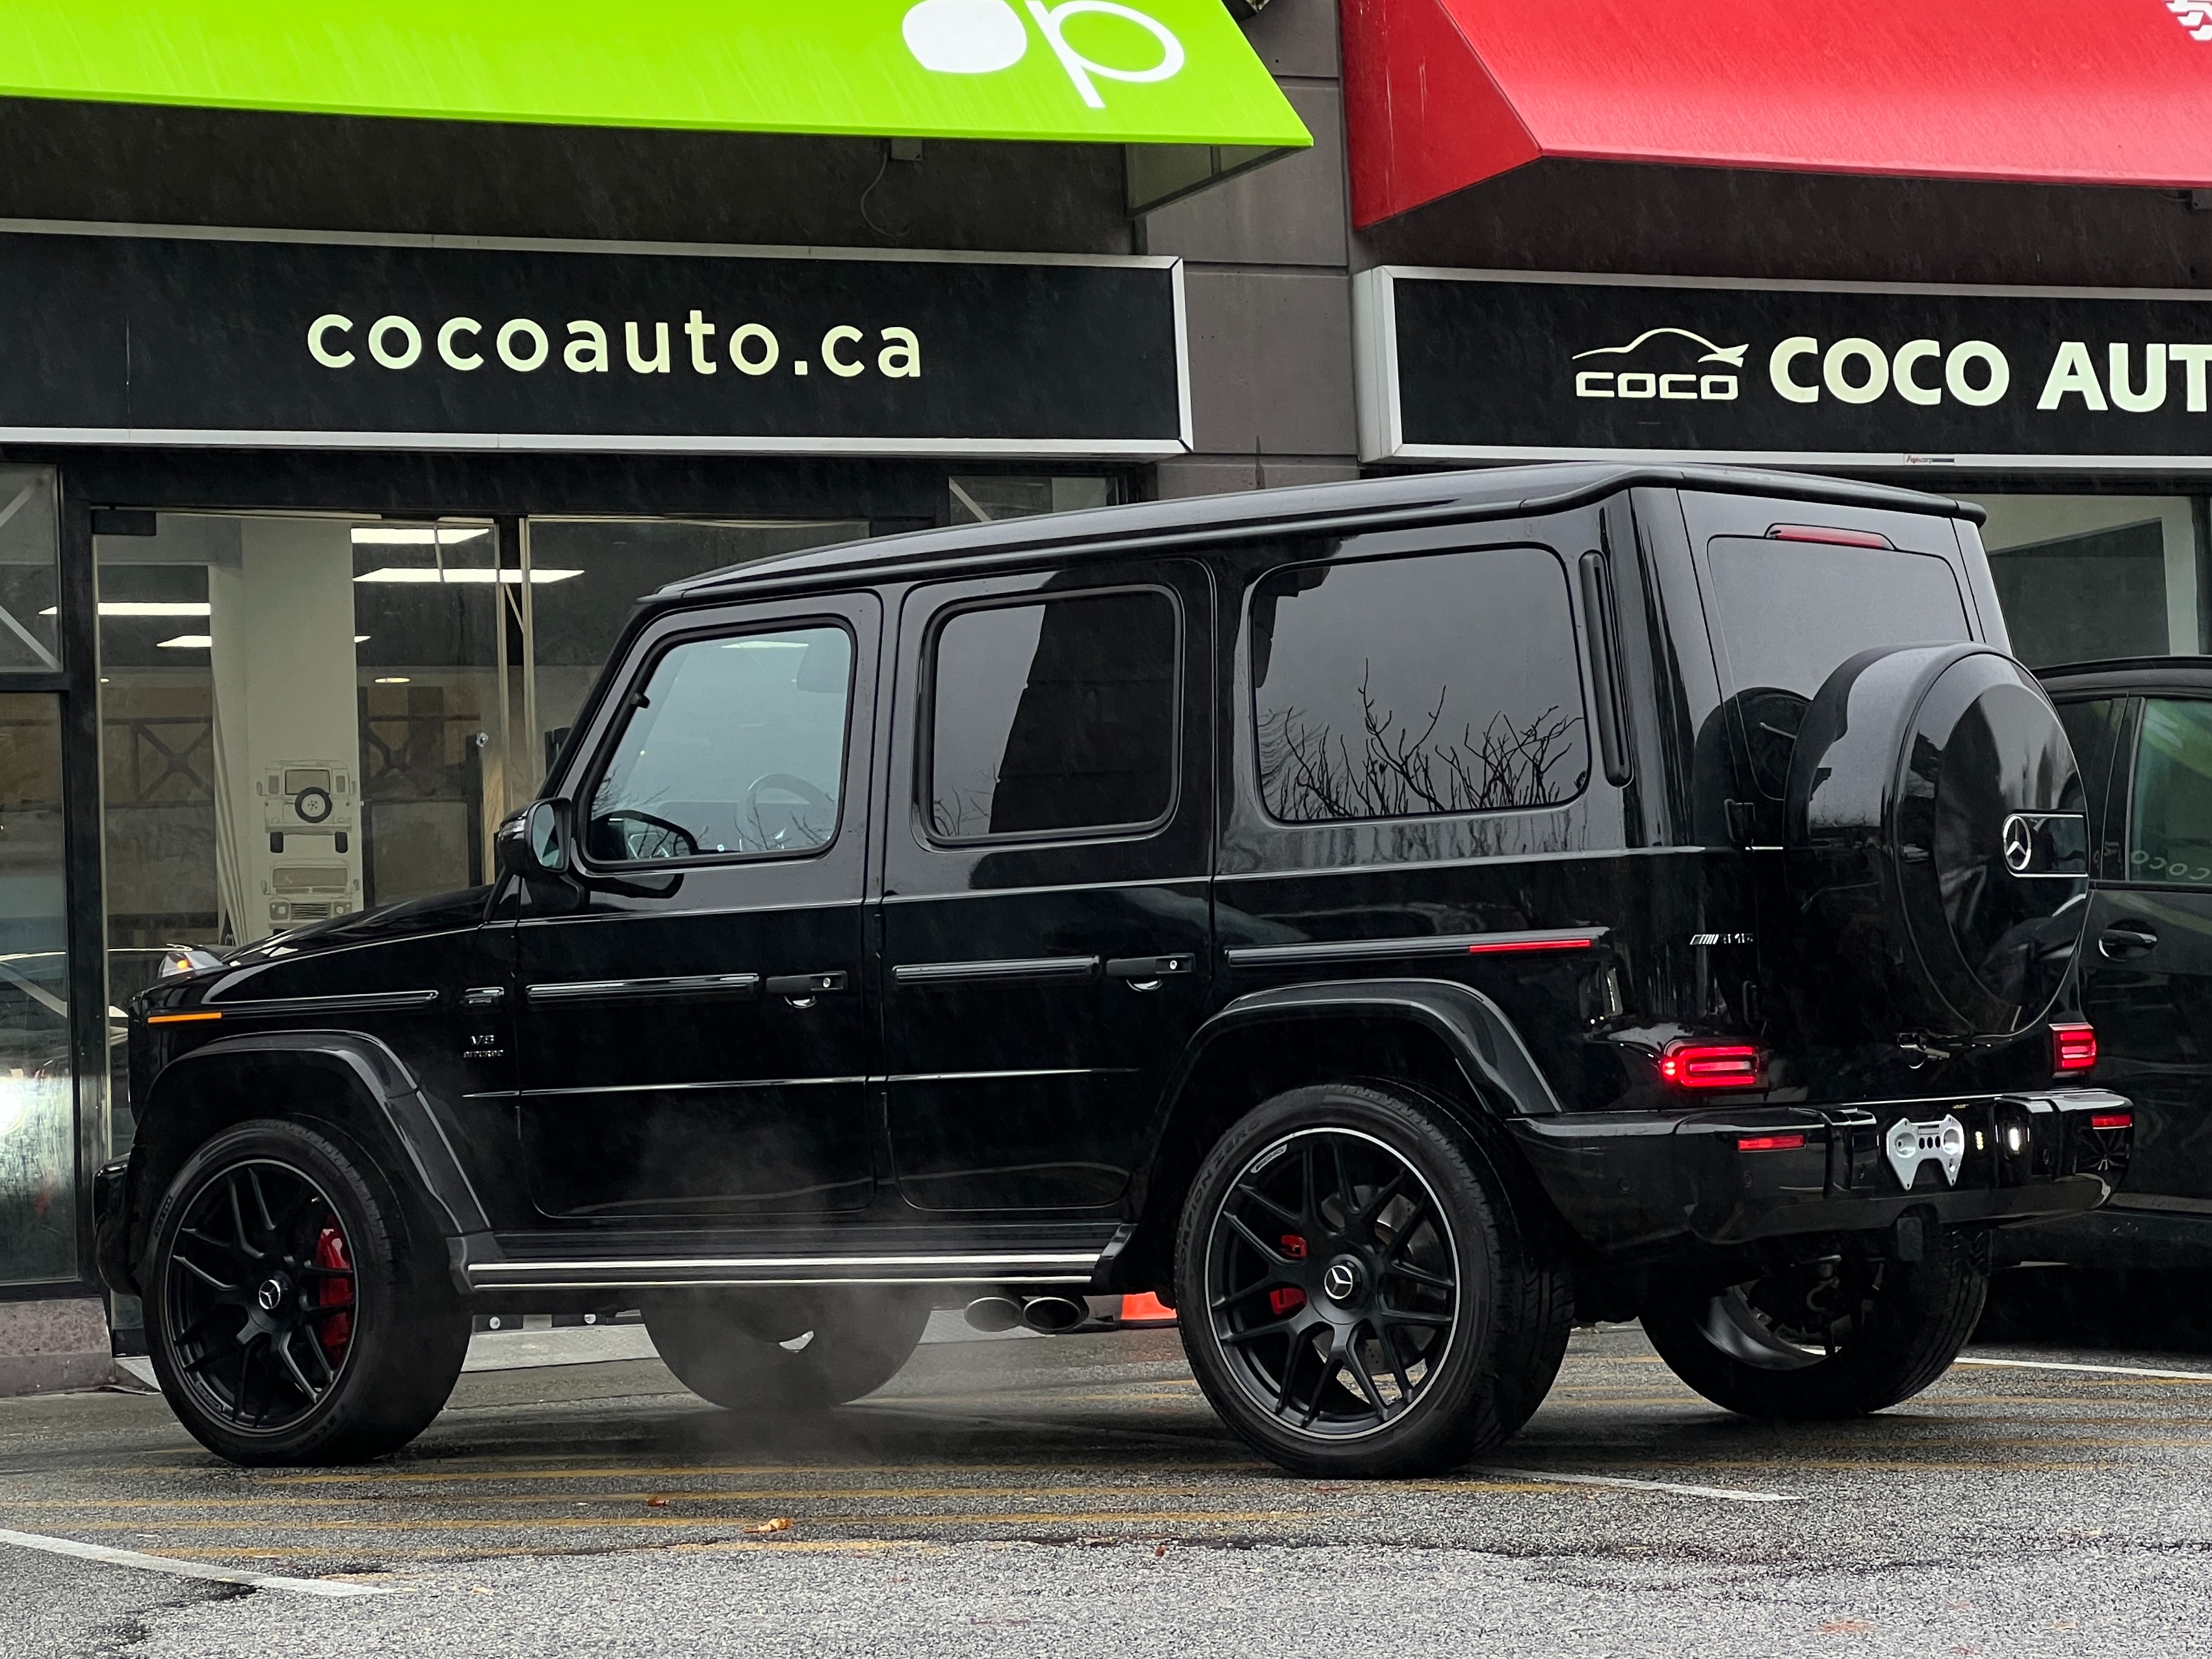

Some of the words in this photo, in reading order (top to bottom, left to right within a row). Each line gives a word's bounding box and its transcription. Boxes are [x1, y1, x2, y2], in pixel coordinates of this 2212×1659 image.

[307, 310, 920, 377] cocoauto.ca
[1770, 337, 2009, 406] COCO
[2036, 342, 2212, 411] AUT
[1576, 372, 1737, 399] COCO
